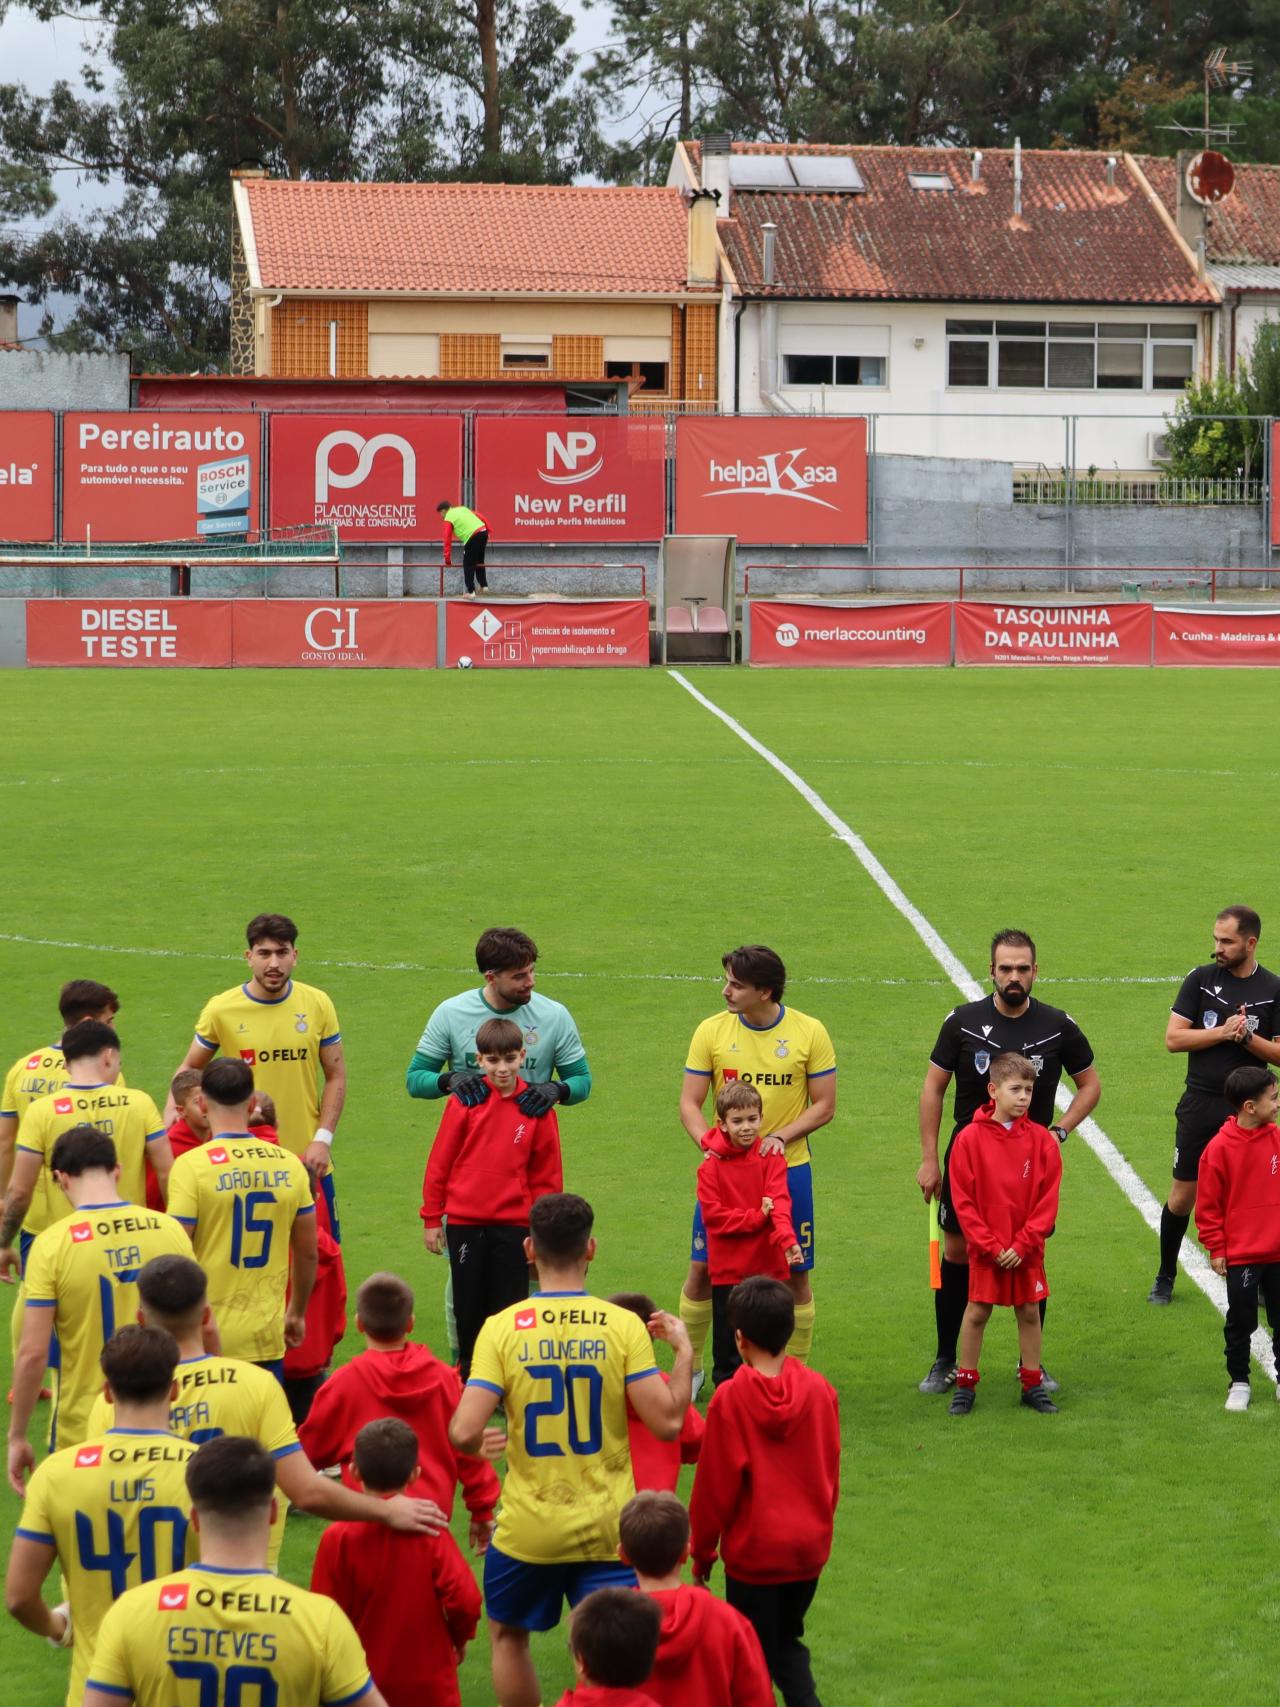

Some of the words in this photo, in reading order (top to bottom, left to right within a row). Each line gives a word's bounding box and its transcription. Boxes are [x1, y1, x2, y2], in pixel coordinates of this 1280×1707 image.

[79, 422, 246, 451] Pereirauto
[546, 430, 597, 470] NP
[80, 464, 103, 474] Para
[105, 464, 129, 474] tudo
[131, 466, 138, 474] o
[140, 465, 159, 476] que
[161, 466, 168, 474] o
[170, 466, 189, 474] seu
[199, 464, 247, 484] BOSCH
[709, 447, 838, 490] helpaKasa
[80, 475, 133, 486] automóvel
[135, 475, 185, 486] necessita.
[199, 478, 247, 495] Service
[314, 504, 417, 518] PLACONASCENTE
[514, 494, 564, 513] New
[569, 494, 627, 513] Perfil
[314, 518, 354, 528] MATERIAIS
[355, 518, 366, 528] DE
[368, 517, 417, 529] CONSTRUÇÃO
[514, 517, 556, 528] Produção
[557, 517, 582, 527] Perfis
[584, 517, 627, 527] Metálicos
[81, 609, 177, 631] DIESEL
[993, 608, 1111, 627] TASQUINHA
[304, 607, 360, 651] GI
[531, 626, 561, 636] técnicas
[562, 626, 571, 636] de
[572, 626, 609, 636] isolamento
[610, 628, 616, 636] e
[804, 626, 926, 645] merlaccounting
[1169, 632, 1180, 641] A.
[1182, 632, 1213, 641] Cunha
[1221, 632, 1265, 642] Madeiras
[1268, 632, 1275, 642] &
[81, 635, 177, 658] TESTE
[984, 631, 1012, 647] DA
[1018, 631, 1120, 648] PAULINHA
[301, 652, 336, 661] GOSTO
[338, 652, 367, 661] IDEAL
[596, 645, 605, 655] de
[606, 645, 627, 656] Braga
[42, 1057, 53, 1068] O
[258, 1050, 270, 1063] O
[272, 1047, 308, 1062] FELIZ
[741, 1072, 752, 1085] O
[755, 1072, 793, 1086] FELIZ
[76, 1098, 90, 1110] O
[91, 1095, 130, 1111] FELIZ
[231, 1148, 244, 1162] O
[246, 1147, 286, 1161] FELIZ
[216, 1167, 251, 1191] JOÃO
[254, 1170, 293, 1188] FILIPE
[97, 1222, 110, 1236] O
[114, 1217, 161, 1235] FELIZ
[230, 1191, 278, 1270] 15
[800, 1221, 812, 1248] 5
[104, 1245, 142, 1268] TIGA
[542, 1309, 556, 1324] O
[559, 1310, 608, 1326] FELIZ
[518, 1341, 534, 1362] J.
[182, 1368, 238, 1390] FELIZ
[524, 1364, 603, 1458] 20
[108, 1448, 126, 1463] O
[110, 1478, 156, 1502] LUIS
[75, 1505, 187, 1600] 40
[195, 1588, 216, 1608] O
[221, 1591, 292, 1615] FELIZ
[168, 1626, 277, 1662] ESTEVES
